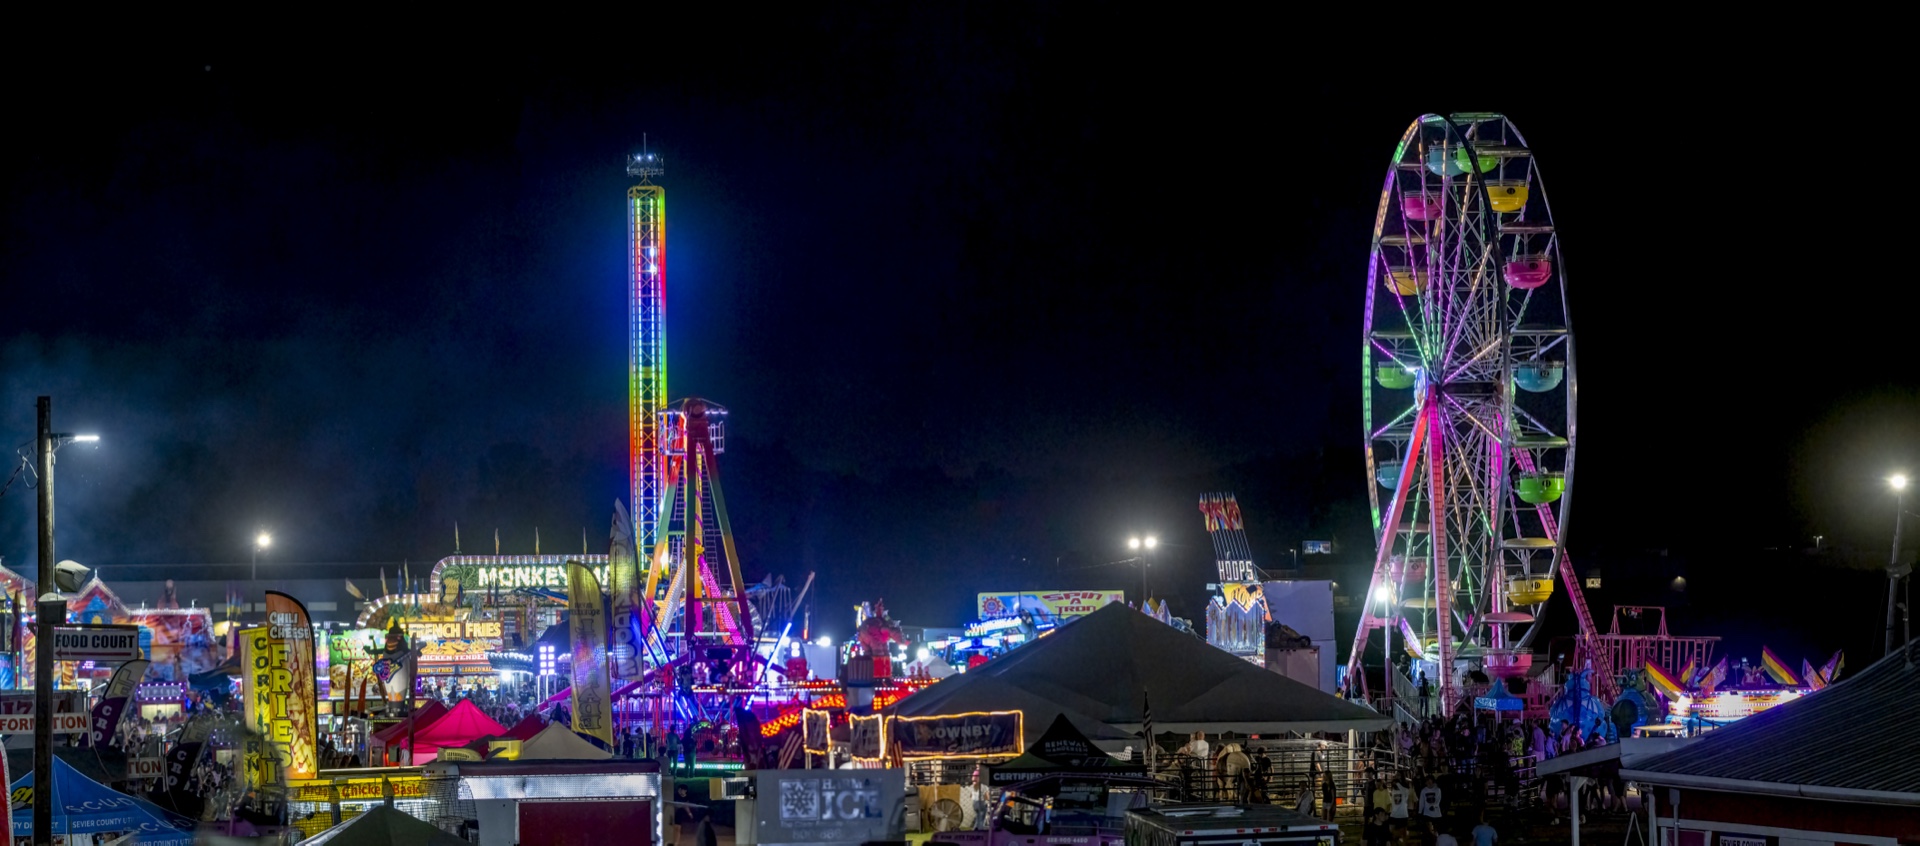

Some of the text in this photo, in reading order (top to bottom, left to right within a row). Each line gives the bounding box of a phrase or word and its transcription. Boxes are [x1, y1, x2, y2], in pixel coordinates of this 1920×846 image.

[1218, 560, 1254, 581] HOOPS
[270, 611, 298, 625] CHILI
[270, 625, 310, 639] CHEESE
[408, 622, 501, 638] FRENCH FRIES
[55, 633, 135, 649] FOOD COURT
[342, 783, 381, 797] Chicke
[72, 820, 95, 828] SEVIER
